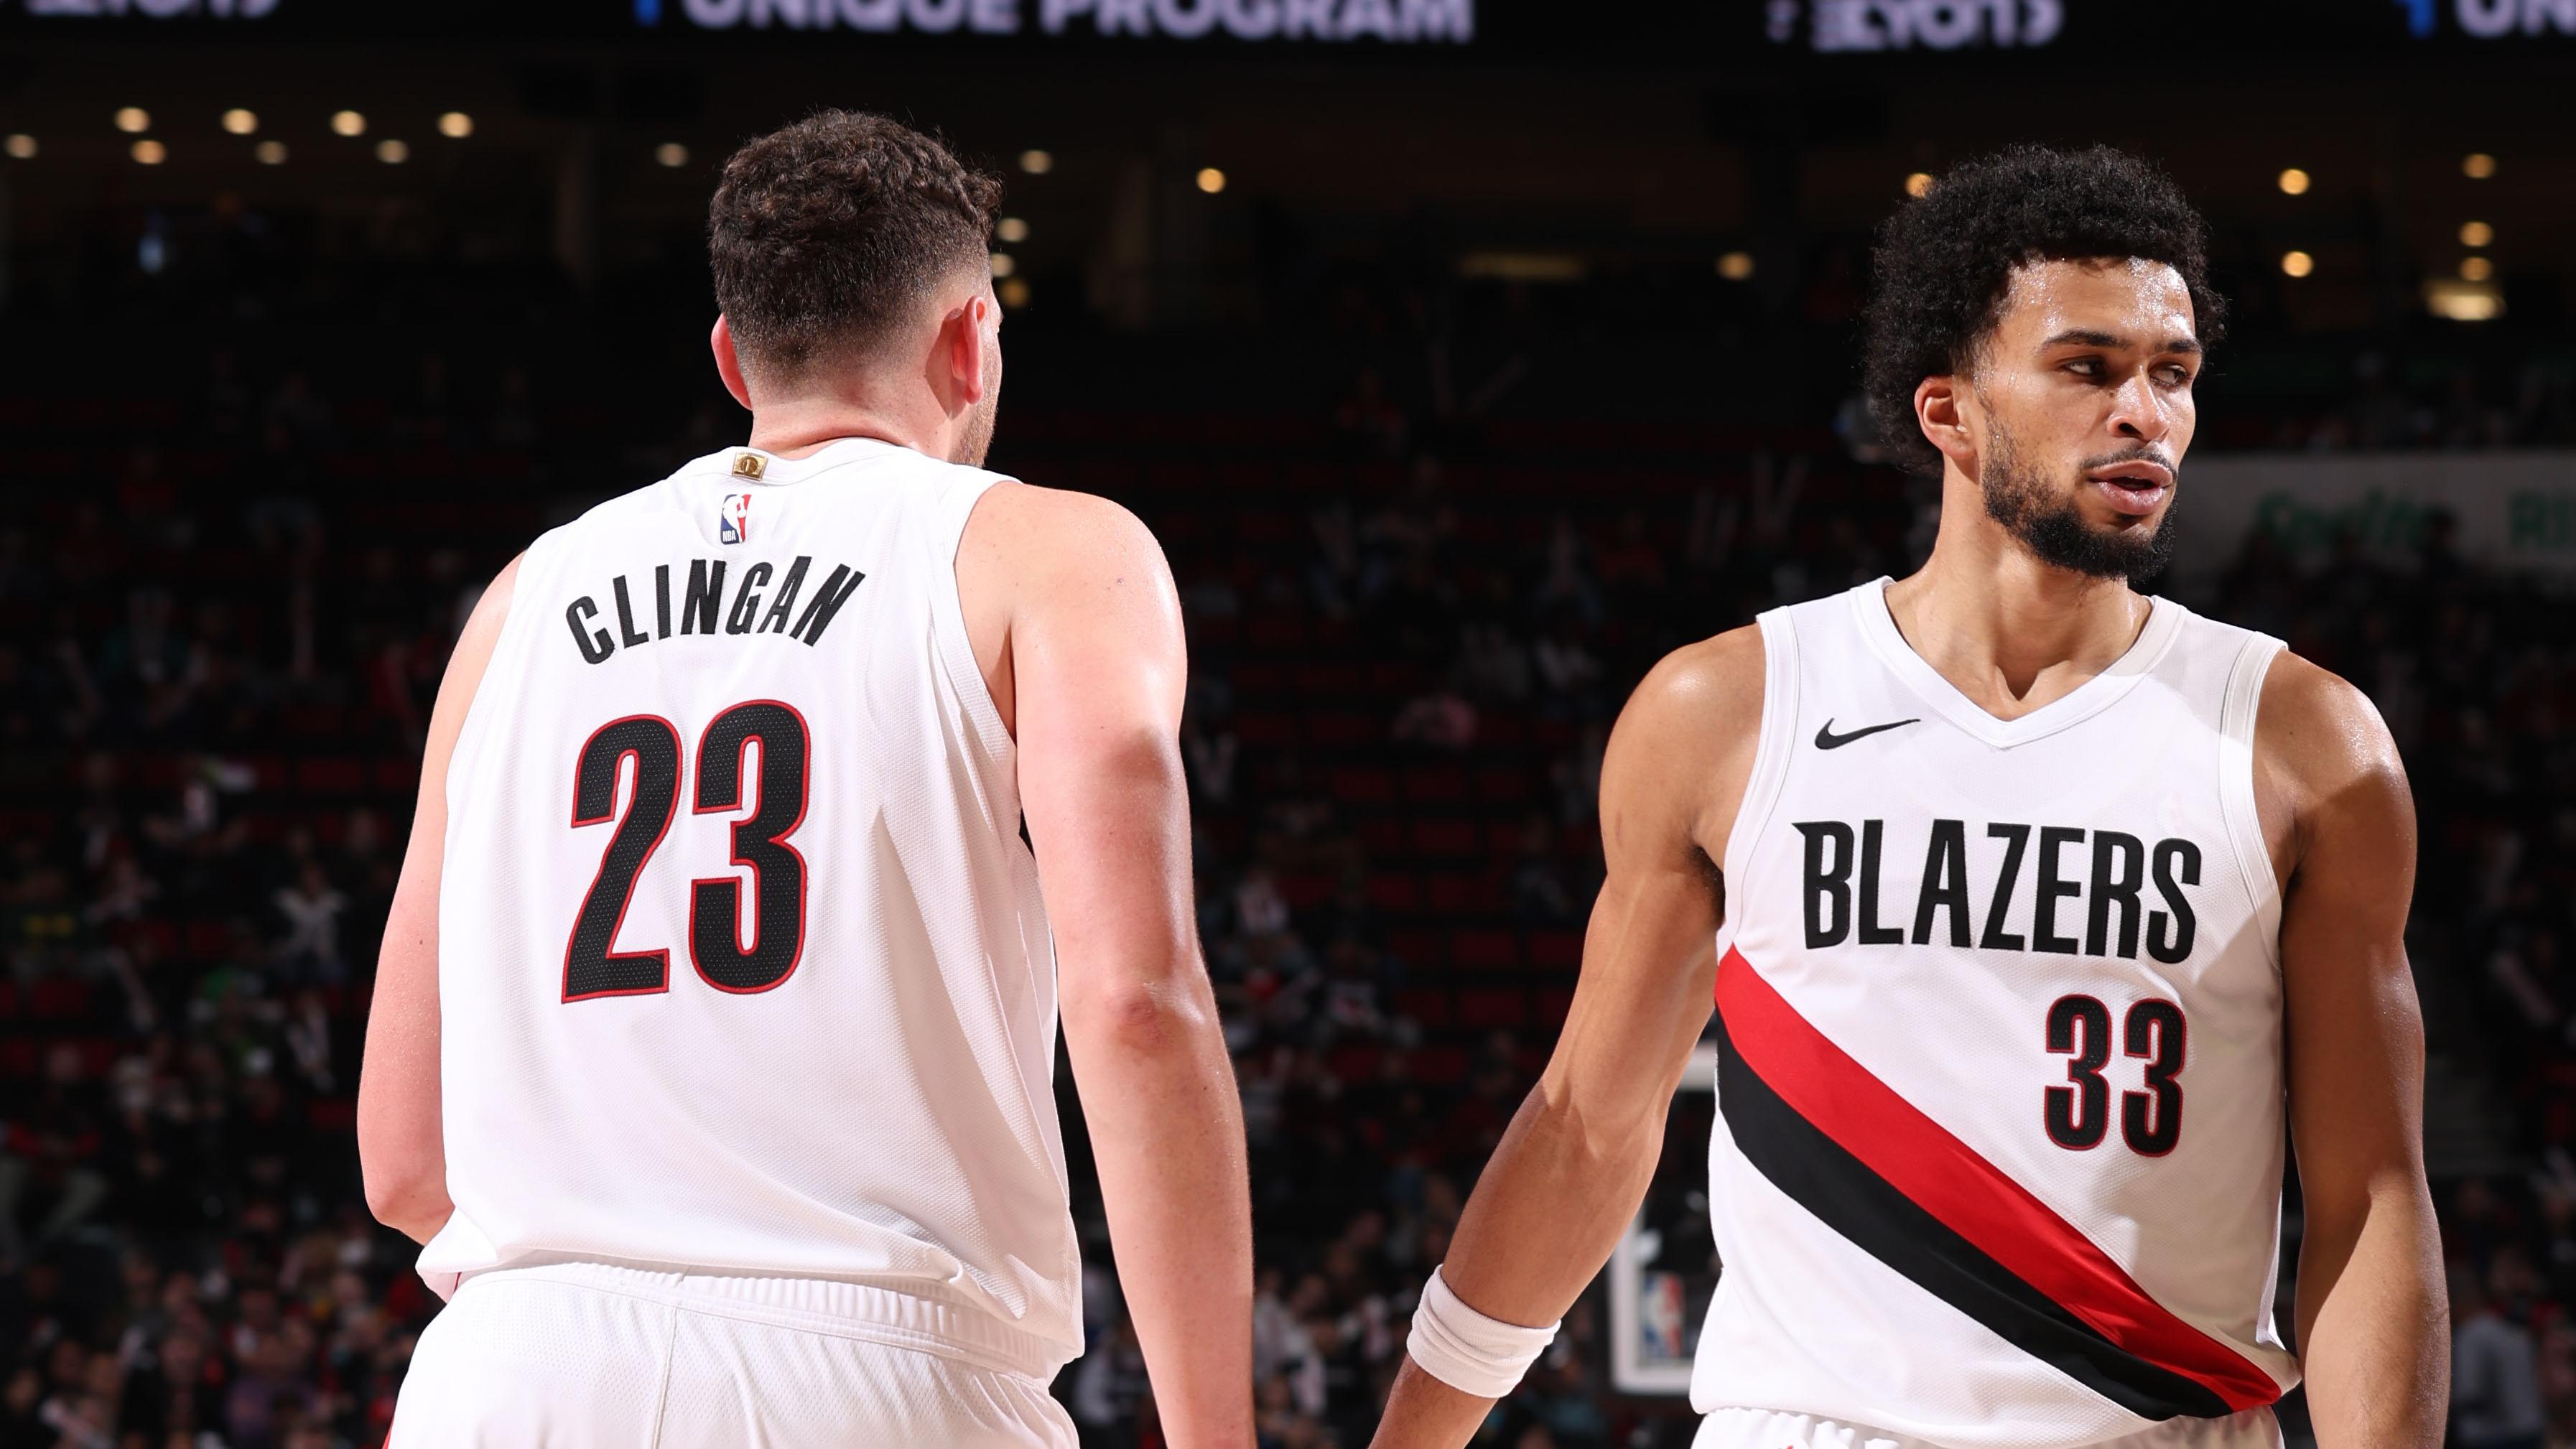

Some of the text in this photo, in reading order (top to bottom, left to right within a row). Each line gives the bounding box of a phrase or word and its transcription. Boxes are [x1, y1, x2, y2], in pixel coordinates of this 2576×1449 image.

[722, 530, 736, 542] NBA
[565, 556, 866, 665] CLINGAN
[561, 699, 812, 1004] 23
[1791, 819, 2202, 964] BLAZERS
[2043, 994, 2187, 1159] 33
